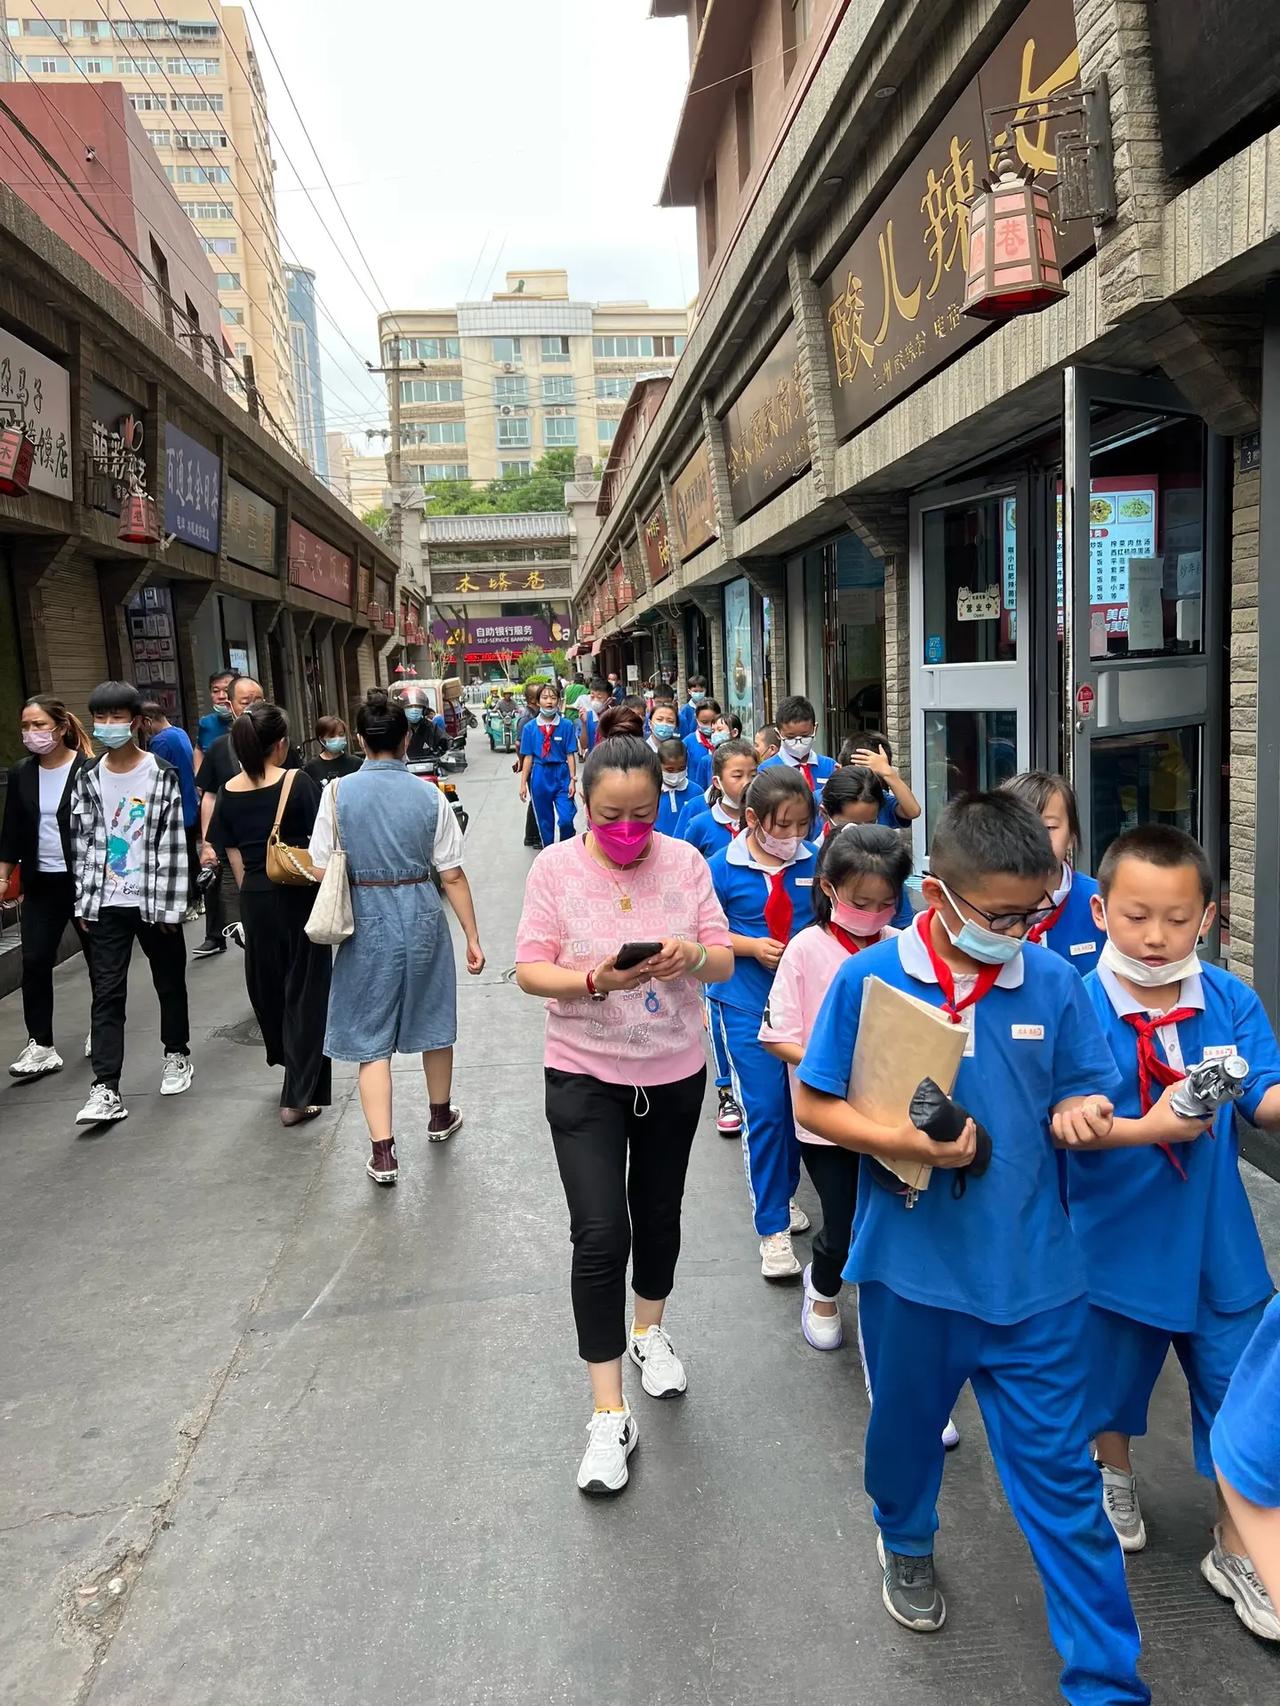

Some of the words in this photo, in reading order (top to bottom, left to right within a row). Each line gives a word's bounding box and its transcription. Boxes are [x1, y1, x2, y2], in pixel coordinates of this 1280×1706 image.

[996, 219, 1025, 257] 巷
[455, 570, 545, 593] 木塔巷
[966, 603, 992, 613] 营业中
[476, 625, 533, 638] 自助银行服务
